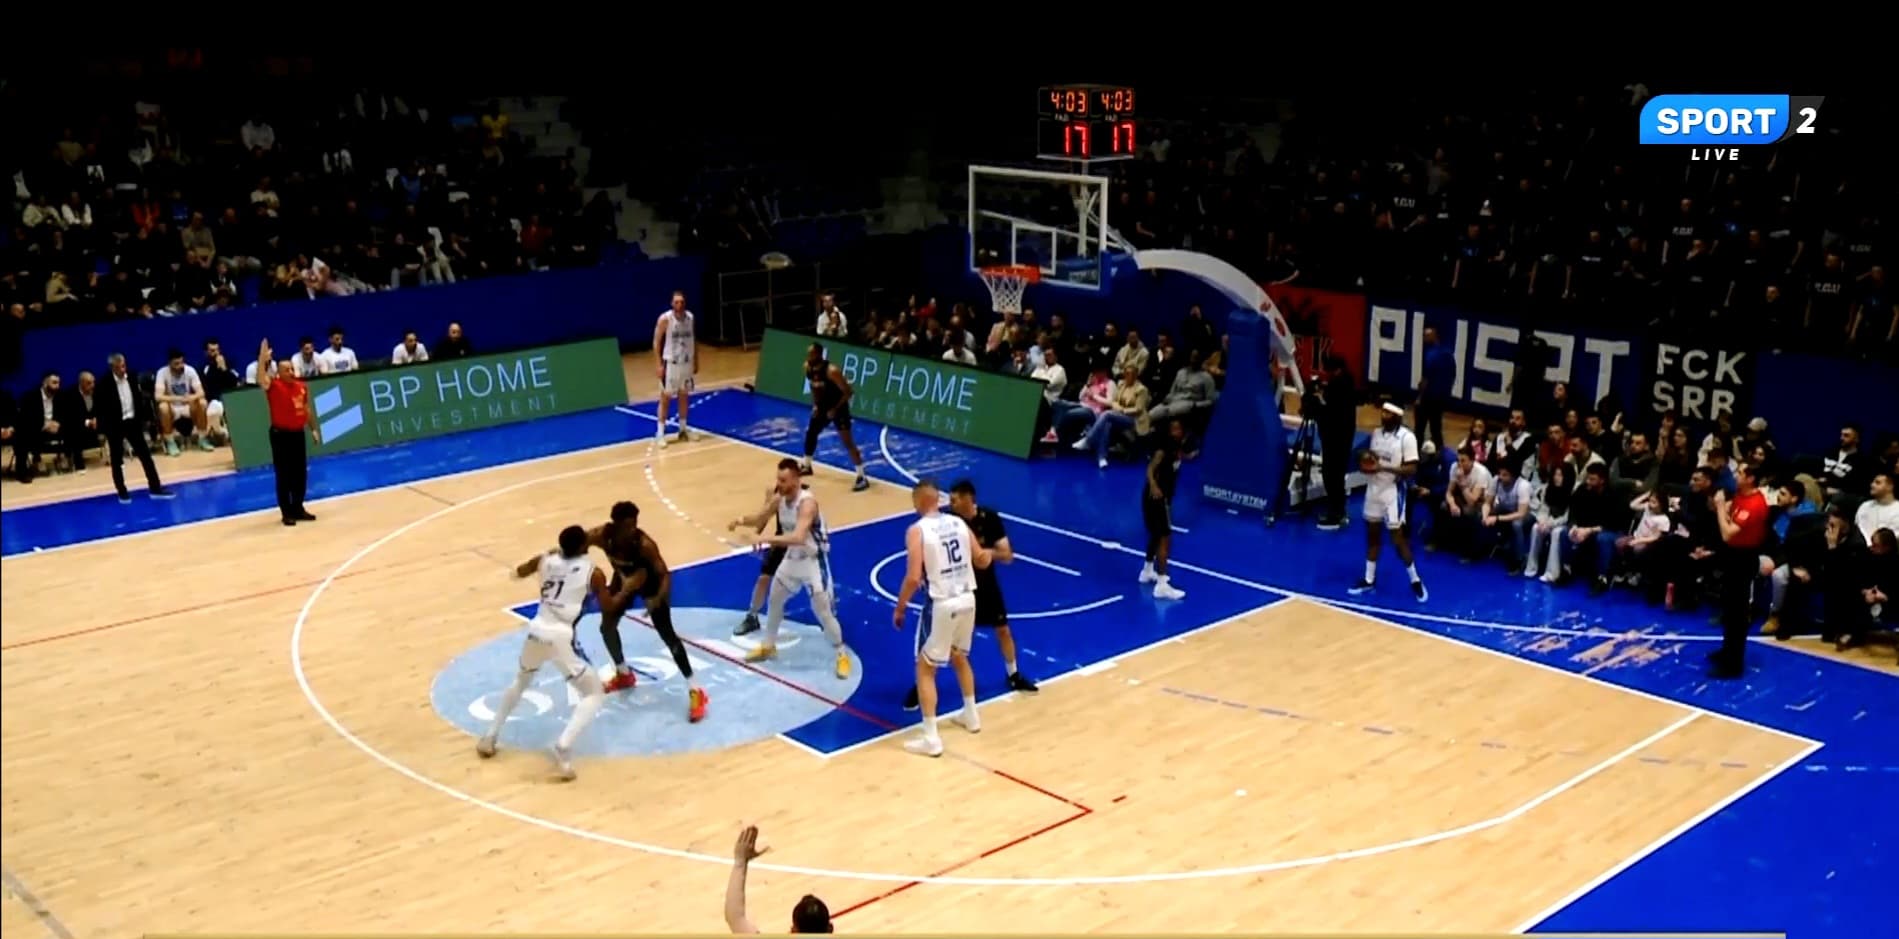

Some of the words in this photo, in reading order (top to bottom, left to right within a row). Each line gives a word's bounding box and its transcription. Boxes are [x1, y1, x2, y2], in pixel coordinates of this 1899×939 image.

[1051, 90, 1086, 112] 4:03
[1101, 89, 1132, 111] 4:03
[1065, 125, 1087, 154] 17
[1113, 123, 1132, 152] 17
[1656, 343, 1746, 384] FCK
[370, 375, 421, 413] BP
[436, 356, 552, 403] HOME
[842, 353, 878, 388] BP
[885, 362, 977, 412] HOME
[376, 393, 557, 437] INVESTMENT
[850, 394, 971, 436] VESTMENT
[1652, 380, 1735, 421] SRR
[942, 539, 962, 565] 12
[541, 580, 564, 600] 21
